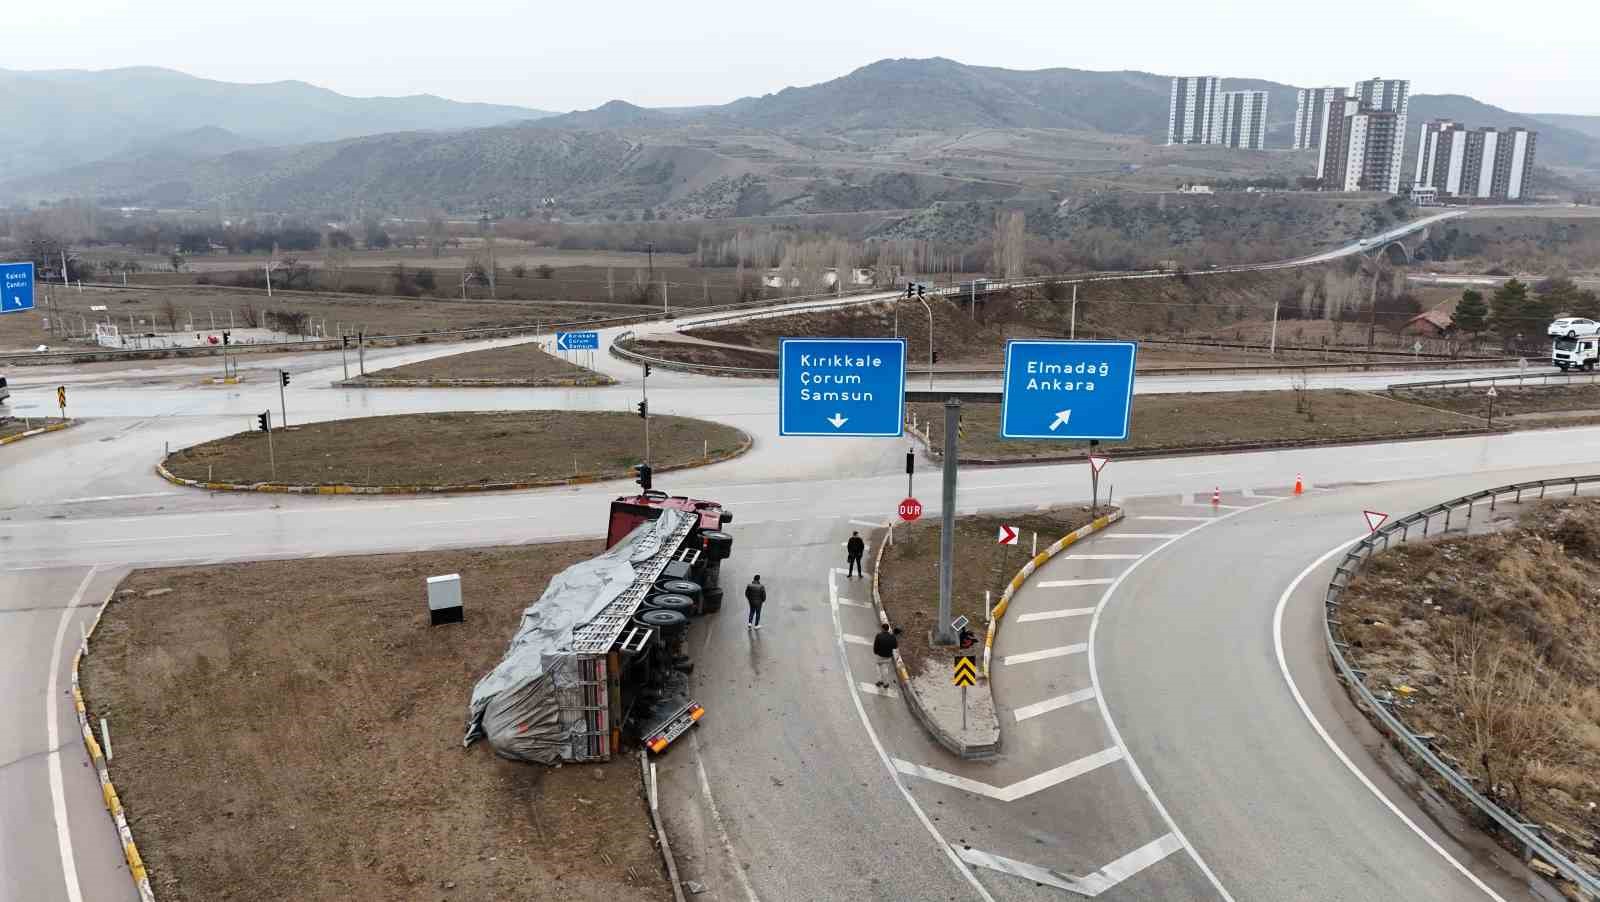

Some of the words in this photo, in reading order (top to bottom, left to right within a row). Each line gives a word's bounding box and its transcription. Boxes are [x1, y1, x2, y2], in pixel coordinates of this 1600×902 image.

[800, 354, 882, 367] Kırıkkale
[1027, 361, 1109, 377] Elmadağ
[800, 371, 861, 385] Çorum
[1026, 378, 1095, 391] Ankara
[800, 389, 873, 401] Samsun
[900, 505, 920, 515] DUR
